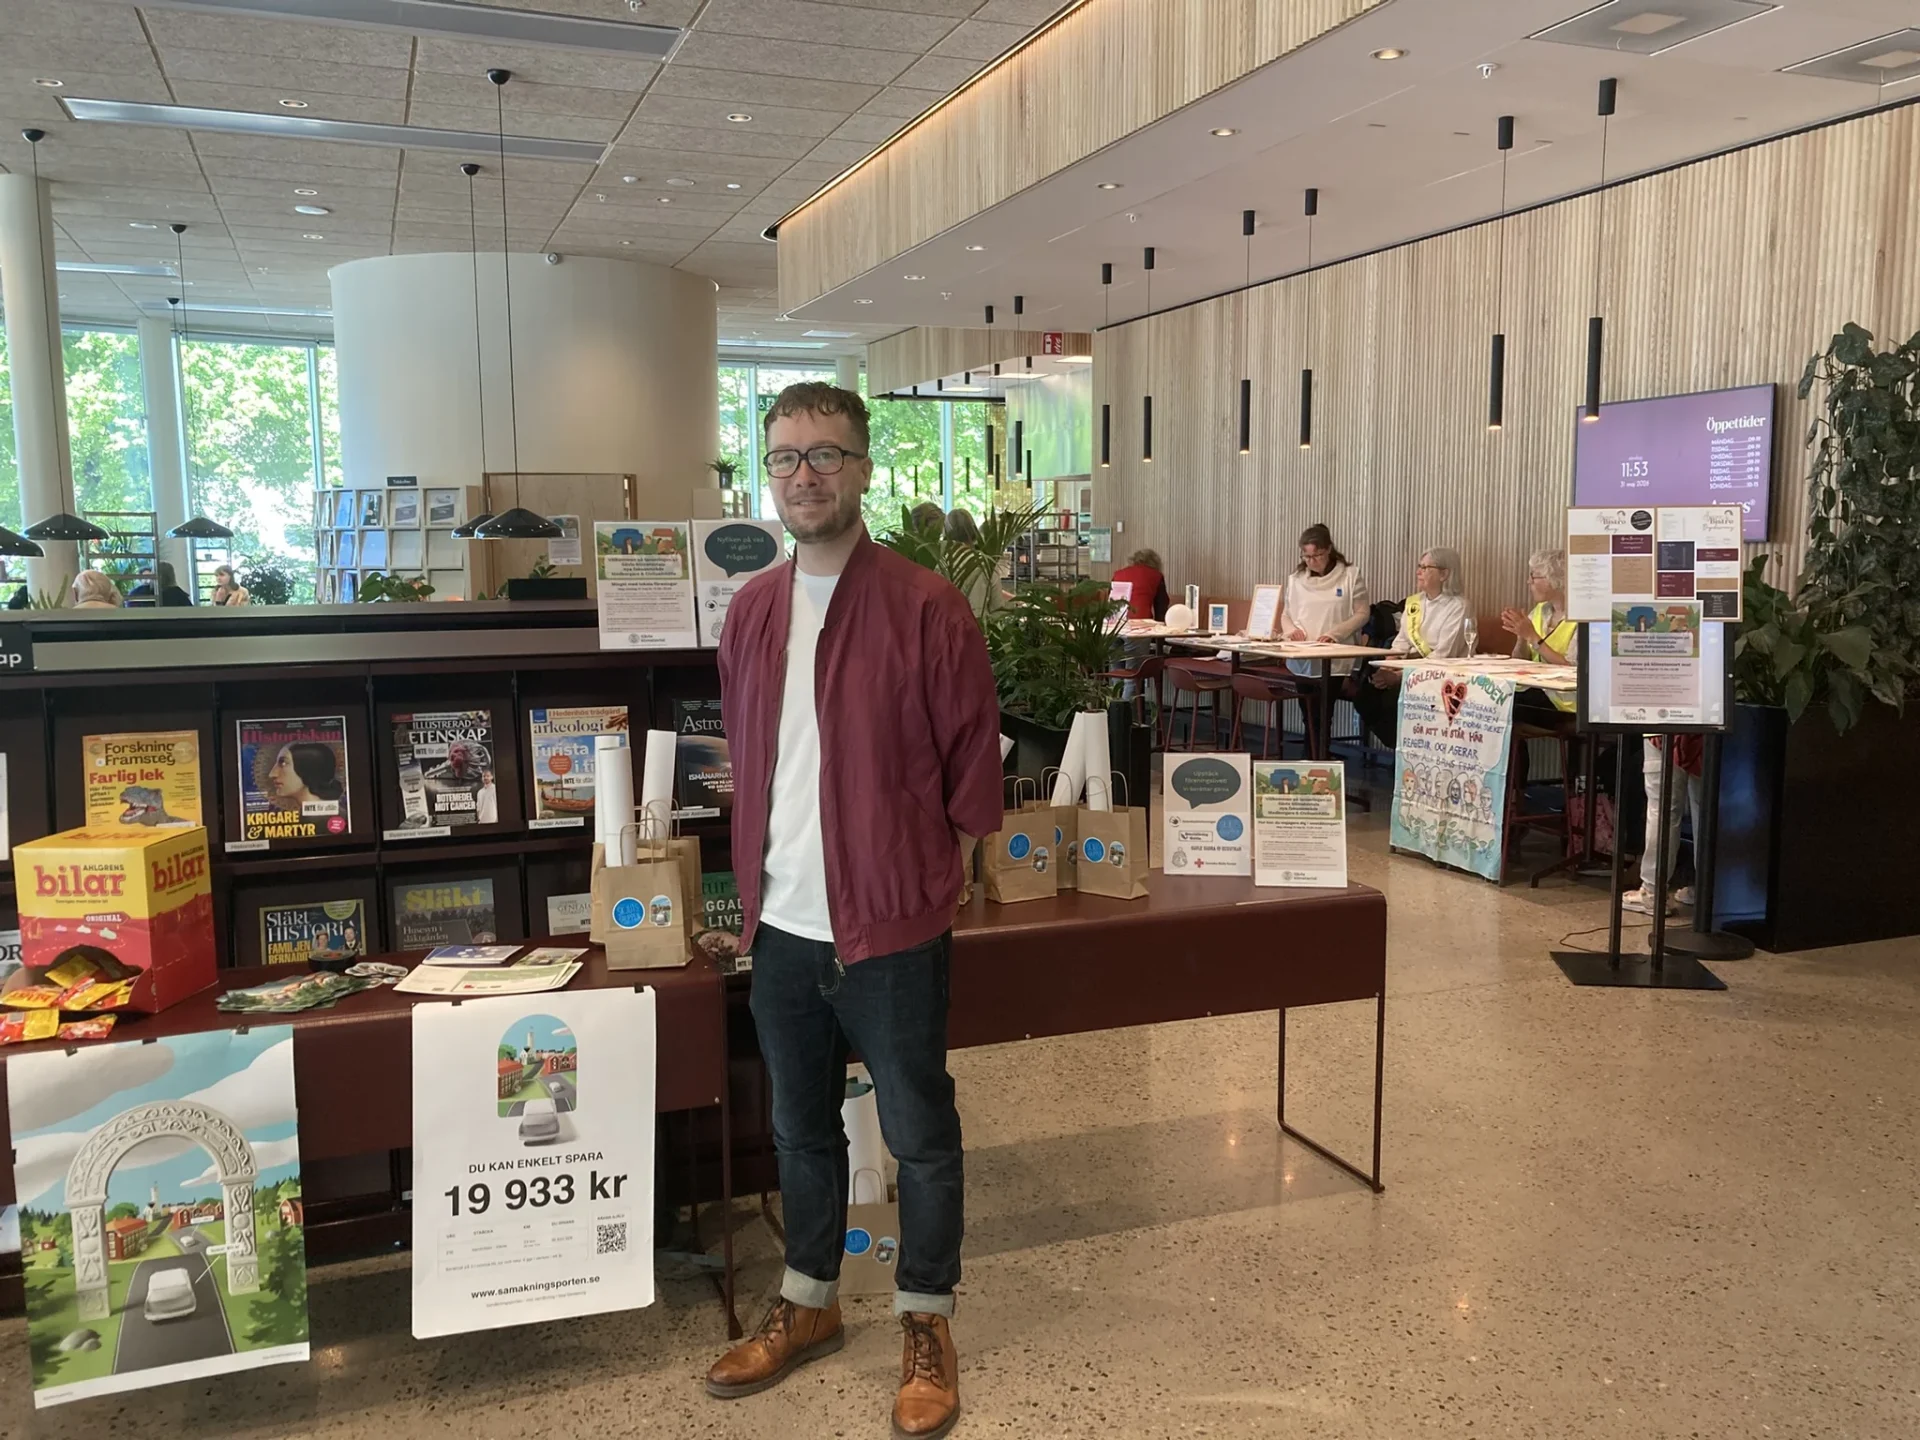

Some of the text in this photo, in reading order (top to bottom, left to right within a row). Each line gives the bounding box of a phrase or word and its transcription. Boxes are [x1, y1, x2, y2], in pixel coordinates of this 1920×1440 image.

[1706, 415, 1766, 434] Öppettider
[1621, 461, 1649, 477] 11:53
[0, 653, 22, 668] ap
[412, 720, 472, 730] ILLUSTRERAD
[533, 719, 604, 734] arkeologi
[681, 715, 726, 733] Astro
[242, 728, 342, 743] Historiskan
[408, 727, 487, 745] ETENSKAP
[533, 744, 590, 757] Turista
[104, 753, 176, 766] Framsteg
[89, 768, 165, 784] Farlig lek
[434, 801, 476, 812] MOT CANCER
[246, 811, 300, 826] KRIGARE
[247, 824, 316, 840] & MARTYR
[152, 853, 206, 892] bilar
[33, 865, 127, 897] bilar
[406, 886, 483, 912] Släkt
[85, 914, 122, 923] ORIGINAL
[267, 911, 310, 927] Släkt
[268, 920, 355, 943] HISTORI
[268, 940, 311, 955] FAMILJEN
[469, 1151, 604, 1174] DU KAN ENKELT SPARA
[445, 1170, 628, 1217] 19 933 kr
[471, 1275, 601, 1299] www.samakningsporten.se
